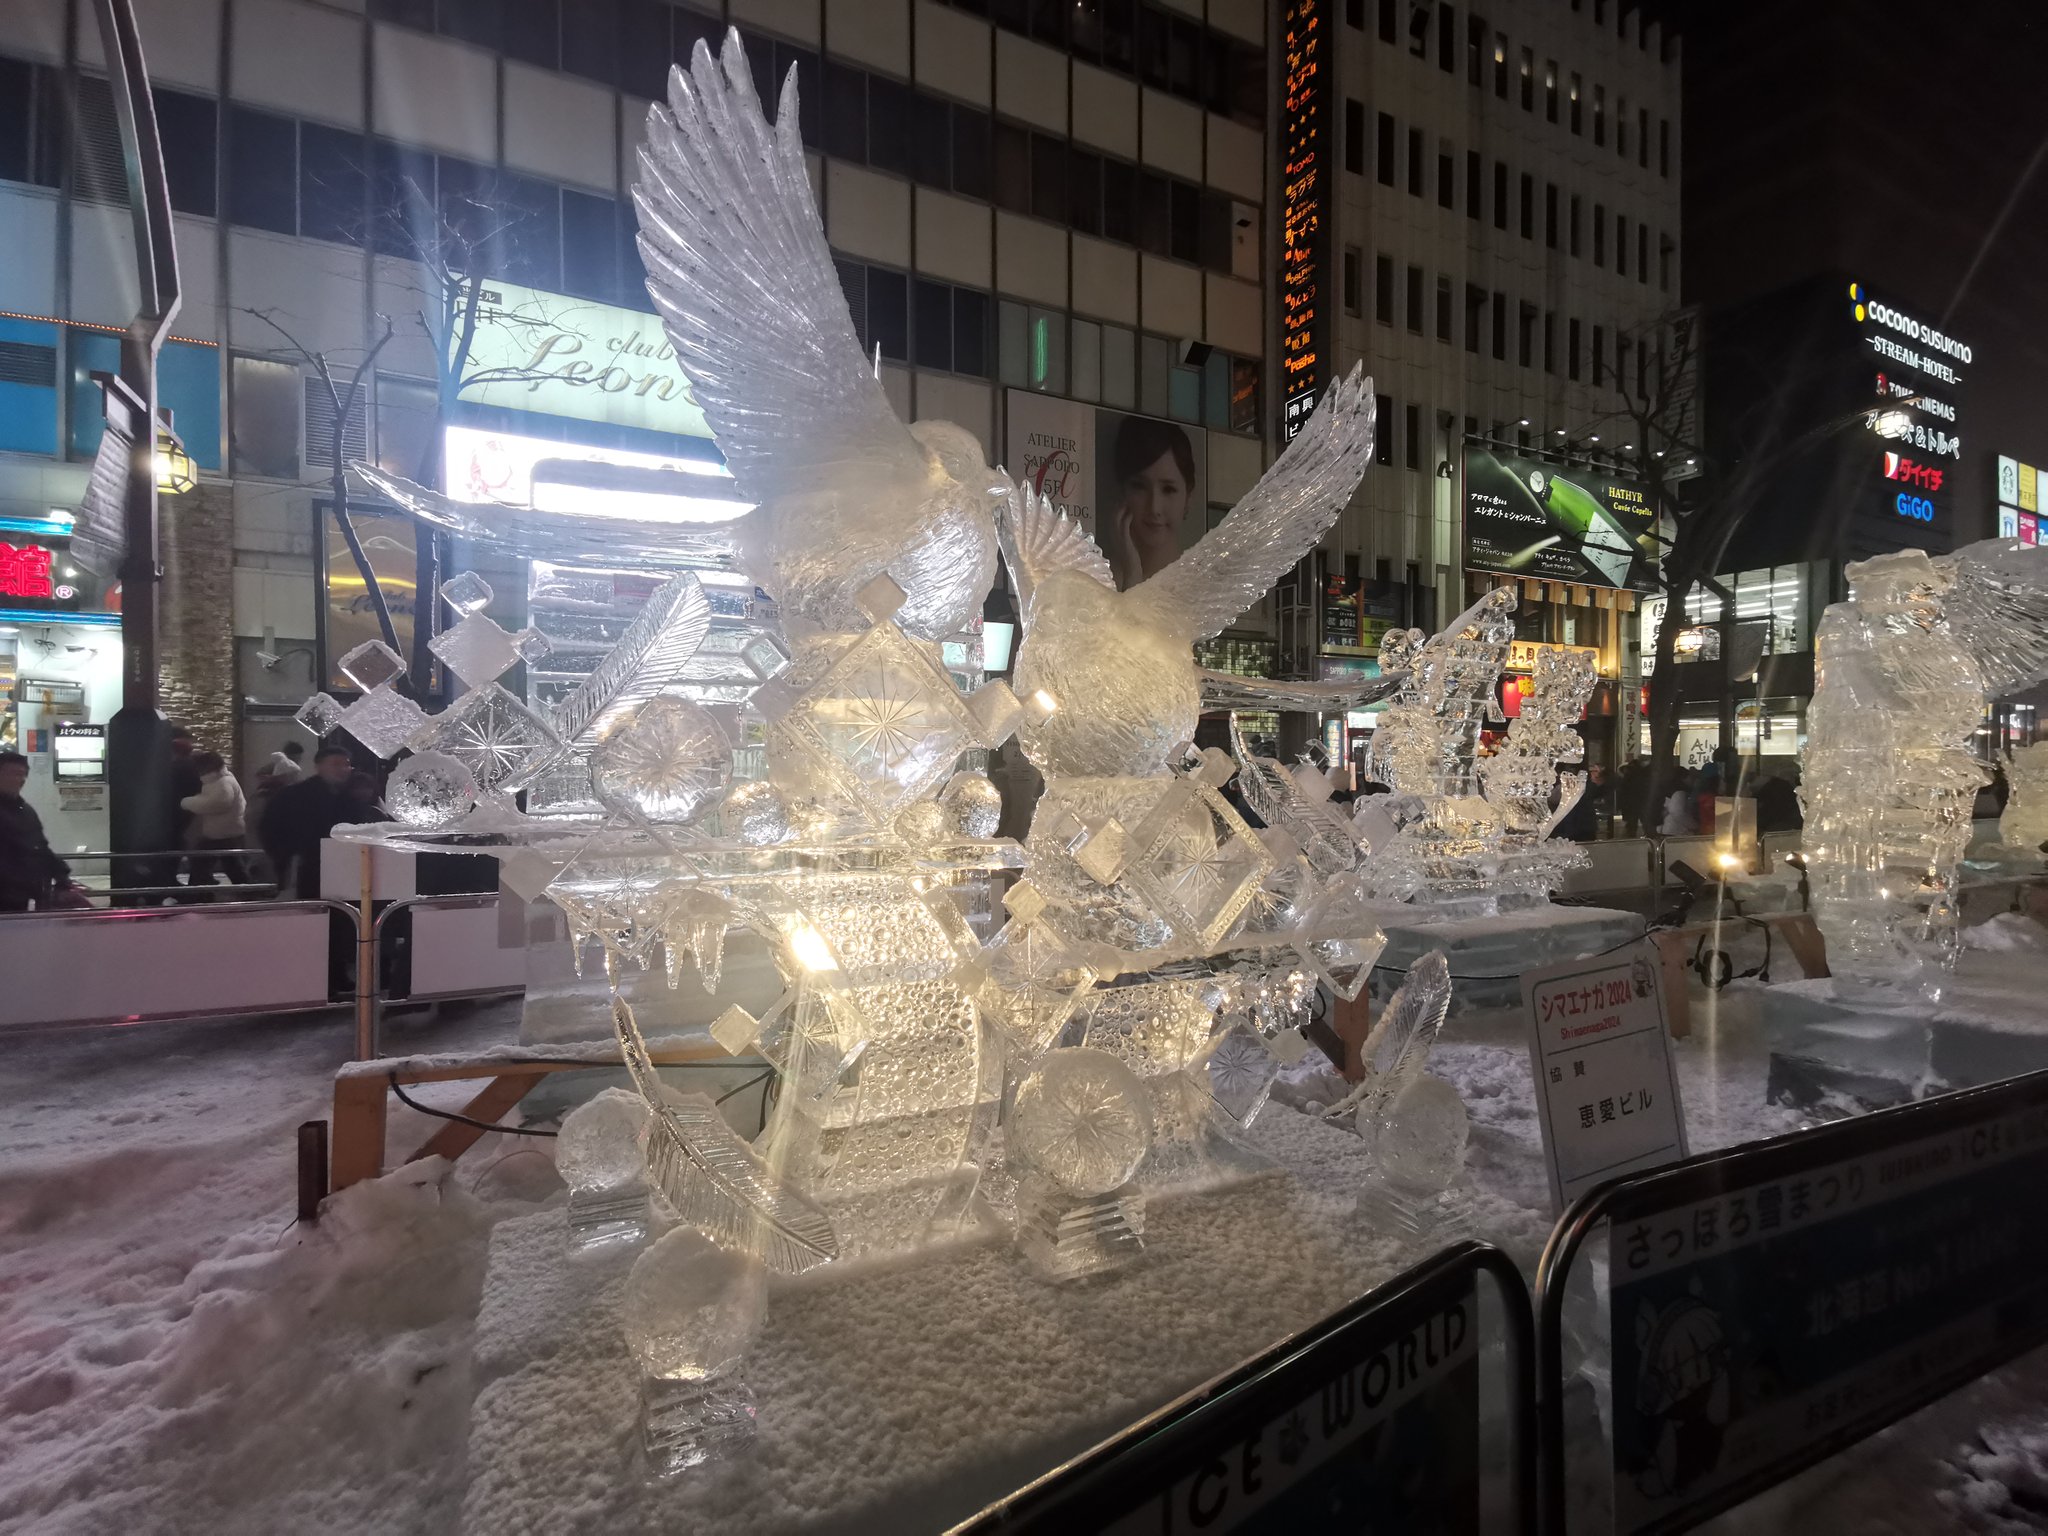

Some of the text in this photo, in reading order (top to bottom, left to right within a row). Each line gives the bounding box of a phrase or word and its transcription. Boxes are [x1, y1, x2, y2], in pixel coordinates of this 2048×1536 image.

[1293, 152, 1315, 175] TOMO
[1868, 300, 1972, 364] COCONO SUSUKINO
[606, 330, 678, 361] club
[1291, 353, 1316, 373] Pasha
[1874, 335, 1956, 384] STREAM HOTEL
[1916, 396, 1956, 422] CINEMAS
[1027, 432, 1077, 453] ATELIER
[1023, 453, 1080, 475] SAPPORO
[1608, 486, 1643, 503] HATHYR
[1613, 501, 1631, 513] Cuvée
[1896, 492, 1935, 522] GiGO
[1540, 978, 1633, 1023] シマエナガ 2024
[1560, 1015, 1621, 1040] Shimaenaga2024
[1549, 1059, 1586, 1084] 協賛
[1578, 1088, 1653, 1129] 恵愛ビル
[1626, 1163, 1866, 1269] さっぽろ雪まつり
[1321, 1302, 1467, 1439] WORLD
